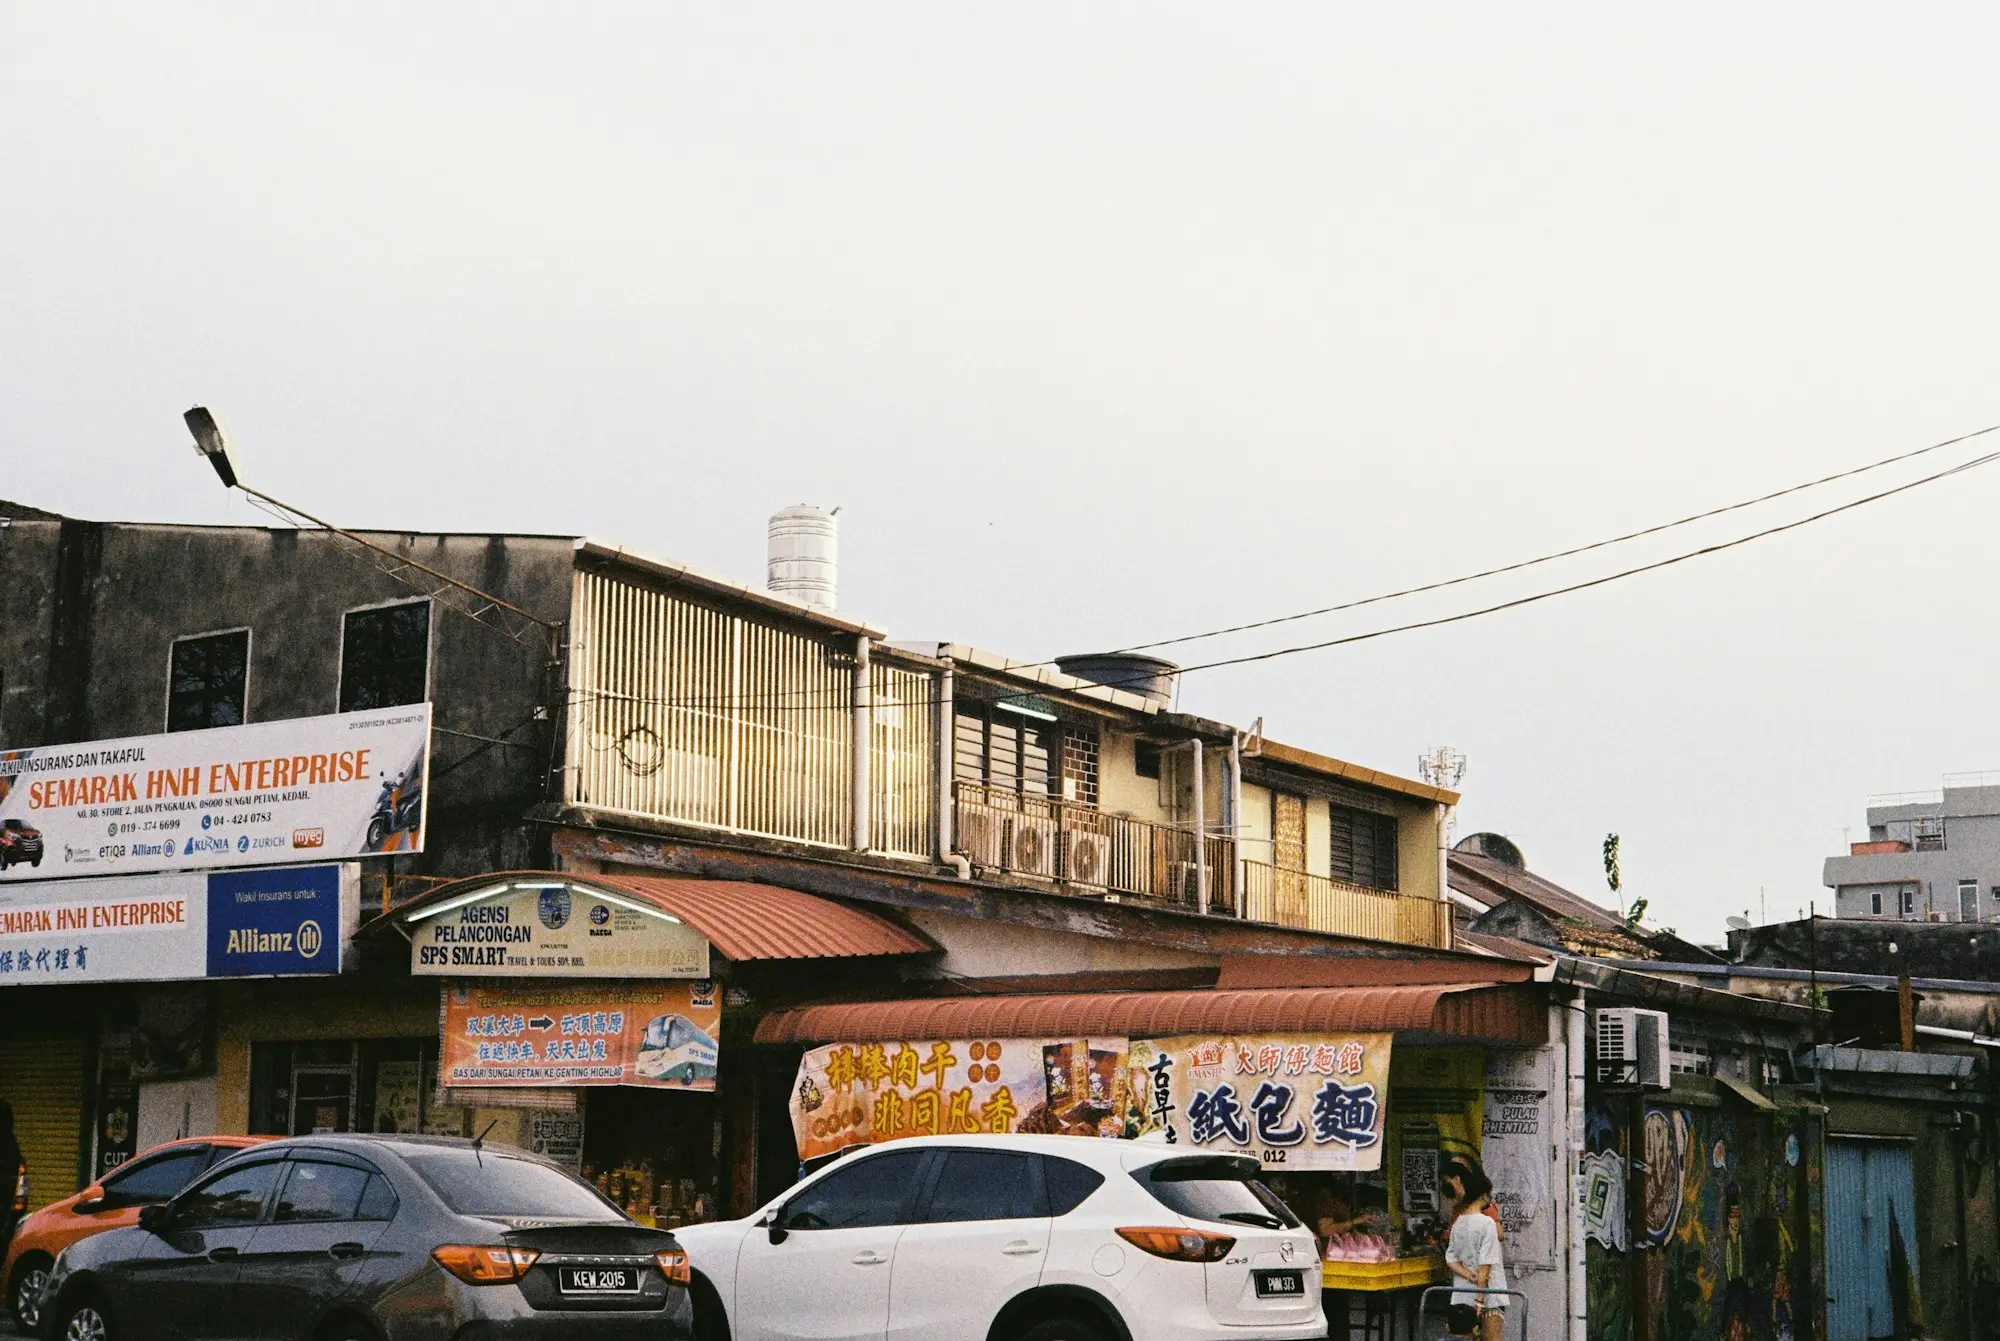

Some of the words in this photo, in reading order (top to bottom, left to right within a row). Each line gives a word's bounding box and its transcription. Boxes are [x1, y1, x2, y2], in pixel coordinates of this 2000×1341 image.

[0, 760, 21, 775] AKIL
[23, 755, 74, 773] INSURANS
[76, 753, 98, 768] DAN
[100, 748, 146, 765] TAKAFUL
[29, 772, 138, 810] SEMARAK
[146, 767, 201, 799] HNH
[208, 749, 371, 794] ENTERPRISE
[134, 804, 153, 814] JALAN
[225, 796, 251, 806] SUNGAI
[120, 823, 136, 833] 019
[143, 821, 157, 831] 374
[159, 819, 181, 830] 6699
[213, 815, 224, 826] 04
[231, 814, 248, 824] 424
[252, 837, 285, 849] ZURICH
[294, 829, 323, 844] myeg
[131, 844, 161, 857] Allianz
[235, 891, 256, 902] Wakil
[258, 890, 292, 901] Insurans
[294, 888, 317, 899] untuk
[56, 907, 87, 930] HNH
[92, 901, 185, 928] ENTERPRISE
[460, 906, 509, 924] AGENSI
[226, 928, 293, 954] Allianz
[435, 925, 531, 943] PELANCONGAN
[420, 946, 448, 965] SPS
[452, 946, 507, 966] SMART
[507, 956, 528, 966] TRAVEL
[466, 1014, 526, 1036] 双溪大年
[561, 1011, 624, 1035] 云顶高原
[453, 1068, 468, 1078] BAS
[470, 1068, 487, 1078] DARI
[488, 1068, 515, 1078] SUNGAI
[516, 1068, 542, 1078] PETANI
[544, 1068, 555, 1078] KE
[556, 1067, 589, 1078] GENTING
[874, 1085, 1018, 1136] 非同凡香
[1503, 1107, 1539, 1120] PULAU
[104, 1151, 128, 1166] CUT
[1263, 1150, 1286, 1163] 012
[1225, 1256, 1249, 1266] CX-5
[573, 1271, 597, 1287] KEW
[599, 1270, 626, 1287] 2015
